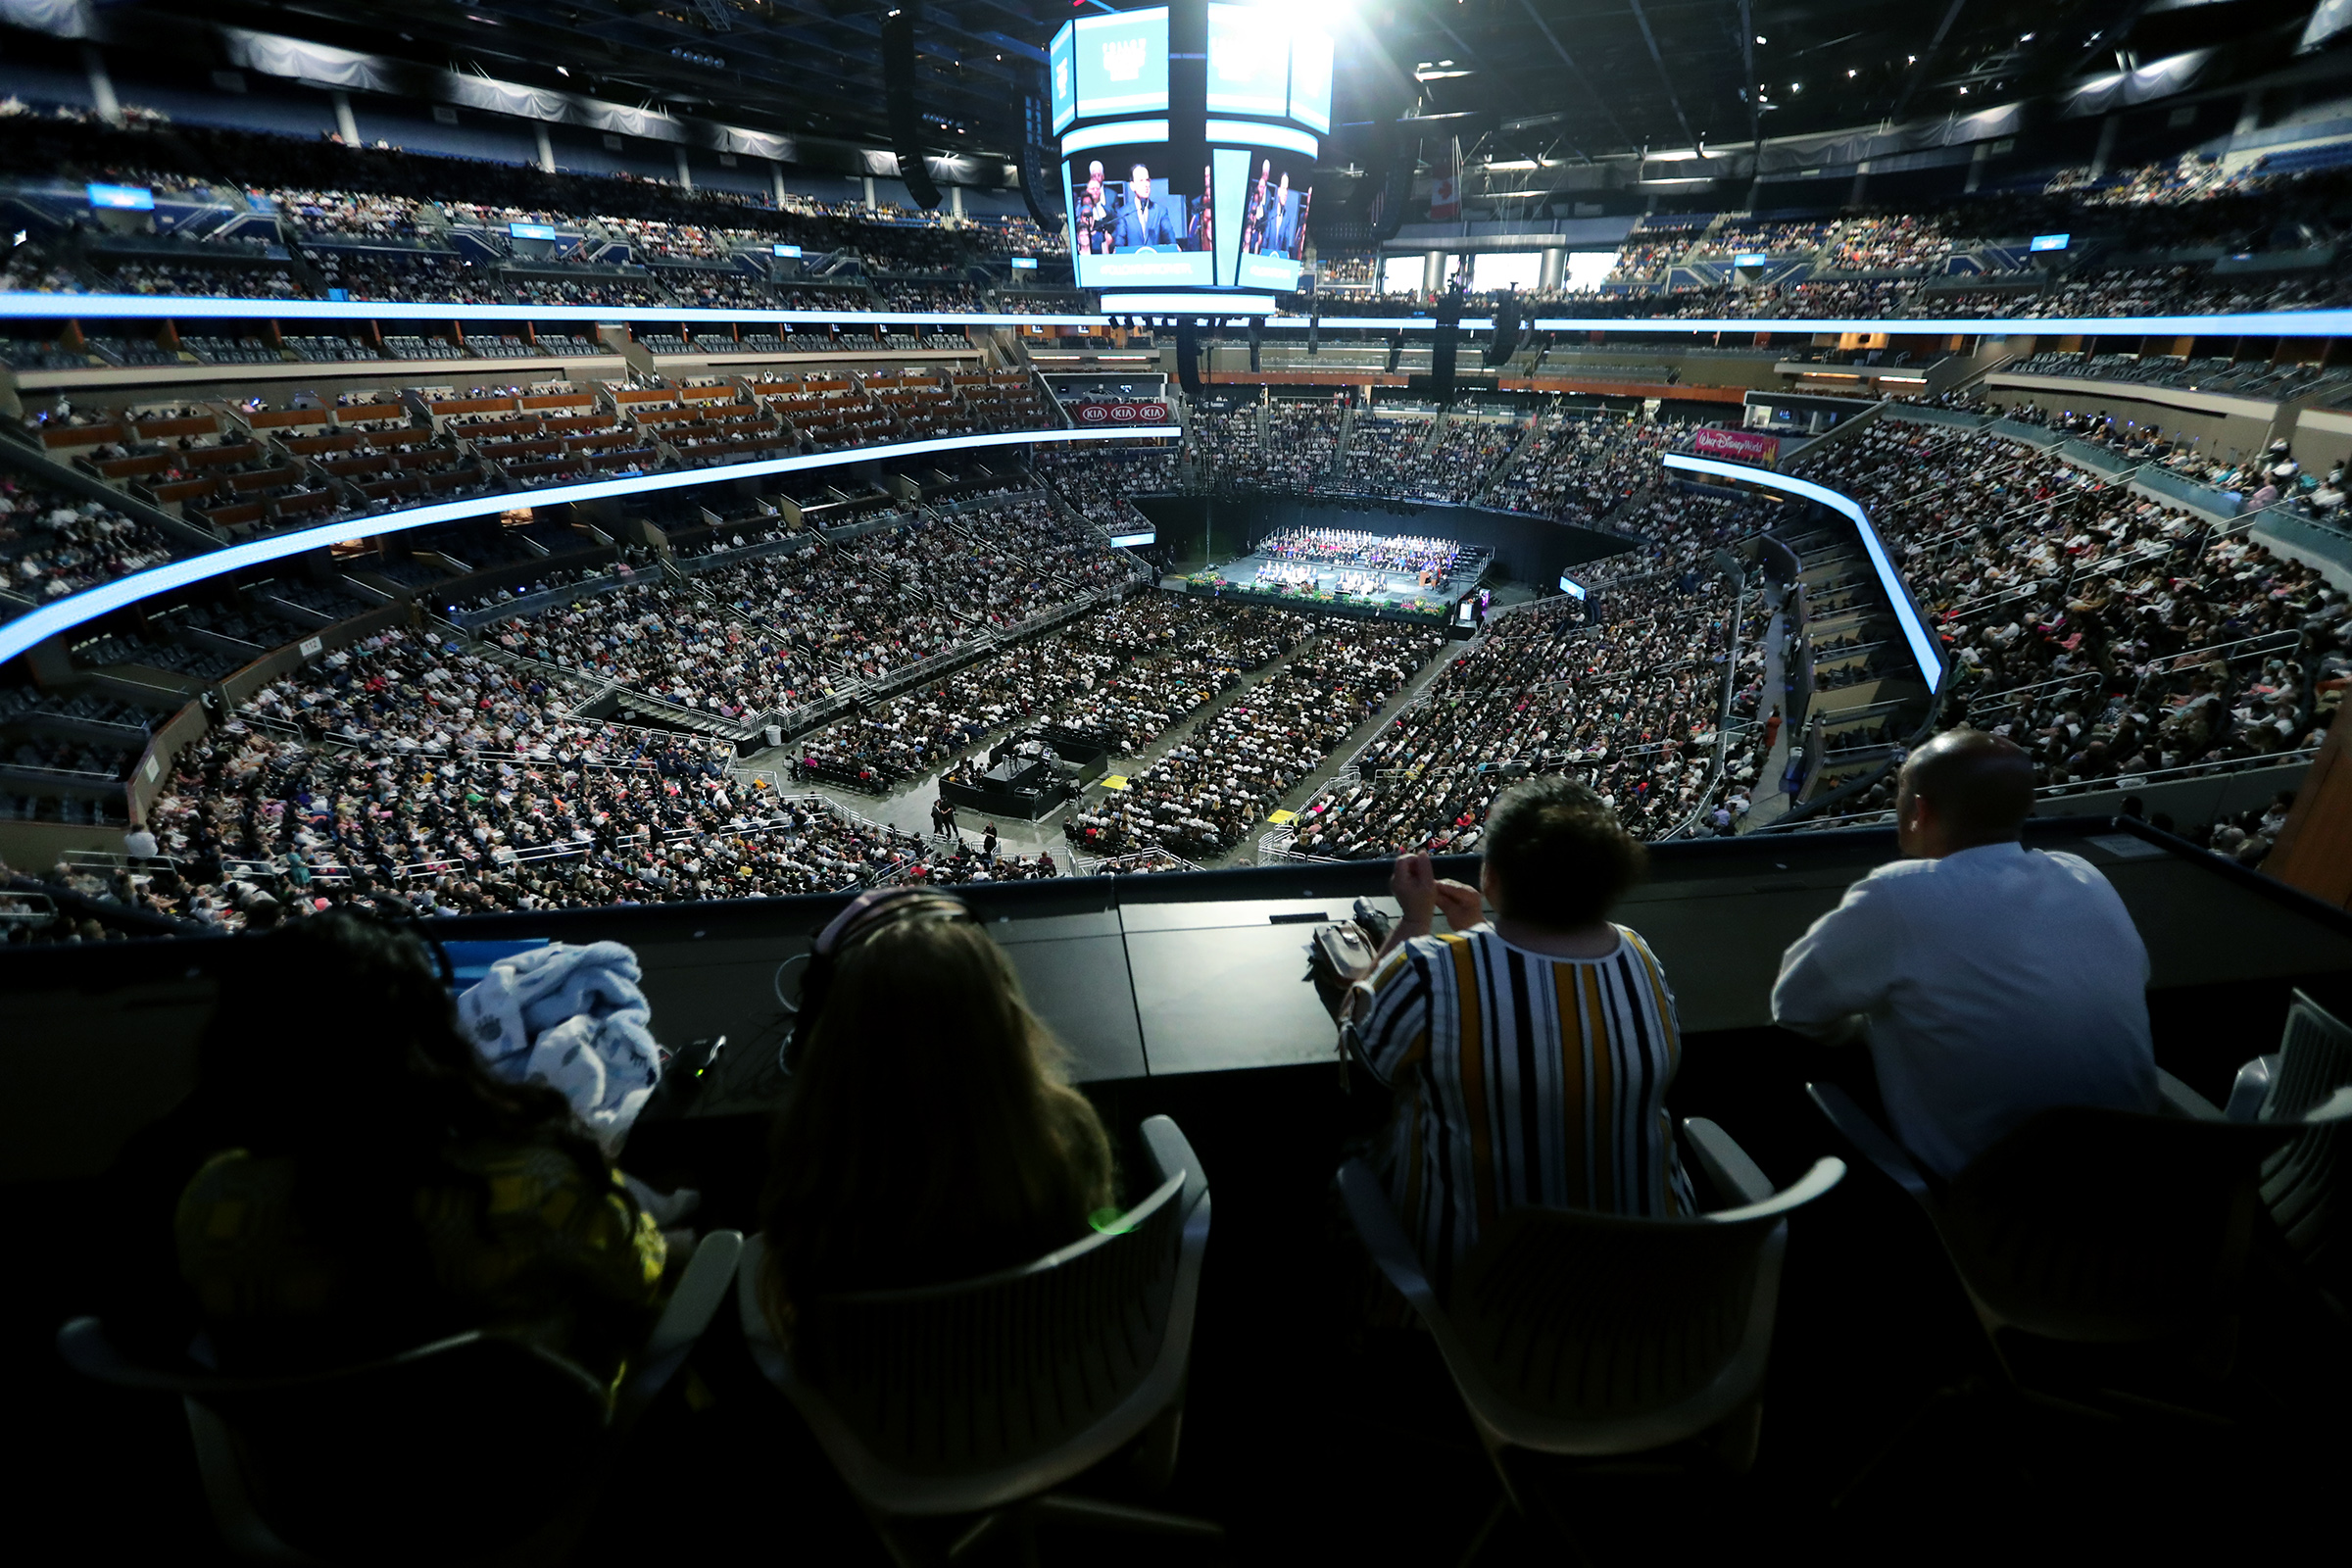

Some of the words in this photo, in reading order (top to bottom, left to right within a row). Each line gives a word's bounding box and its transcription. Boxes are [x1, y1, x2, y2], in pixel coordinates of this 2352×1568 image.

[1087, 410, 1103, 418] KIA
[1115, 409, 1132, 417] KIA
[1144, 409, 1160, 417] KIA
[1716, 433, 1744, 454] Disney
[1744, 440, 1763, 453] World
